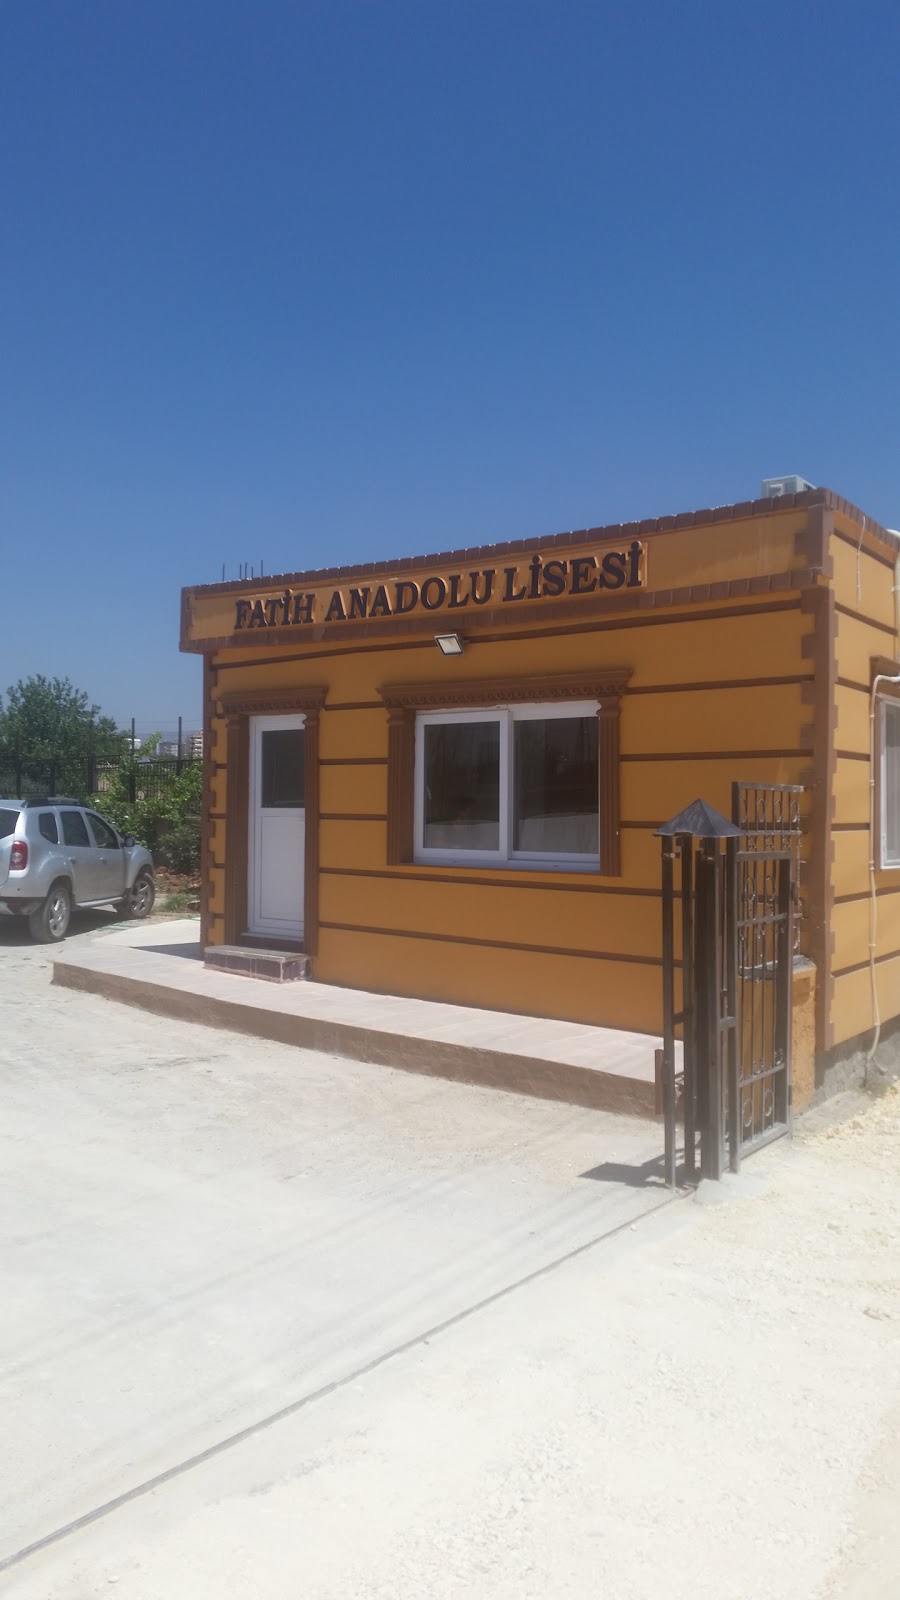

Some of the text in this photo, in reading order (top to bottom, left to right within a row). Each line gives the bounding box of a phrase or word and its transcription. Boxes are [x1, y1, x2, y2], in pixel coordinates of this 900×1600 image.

[234, 540, 643, 630] FATİH ANADOLU LİSESİ
